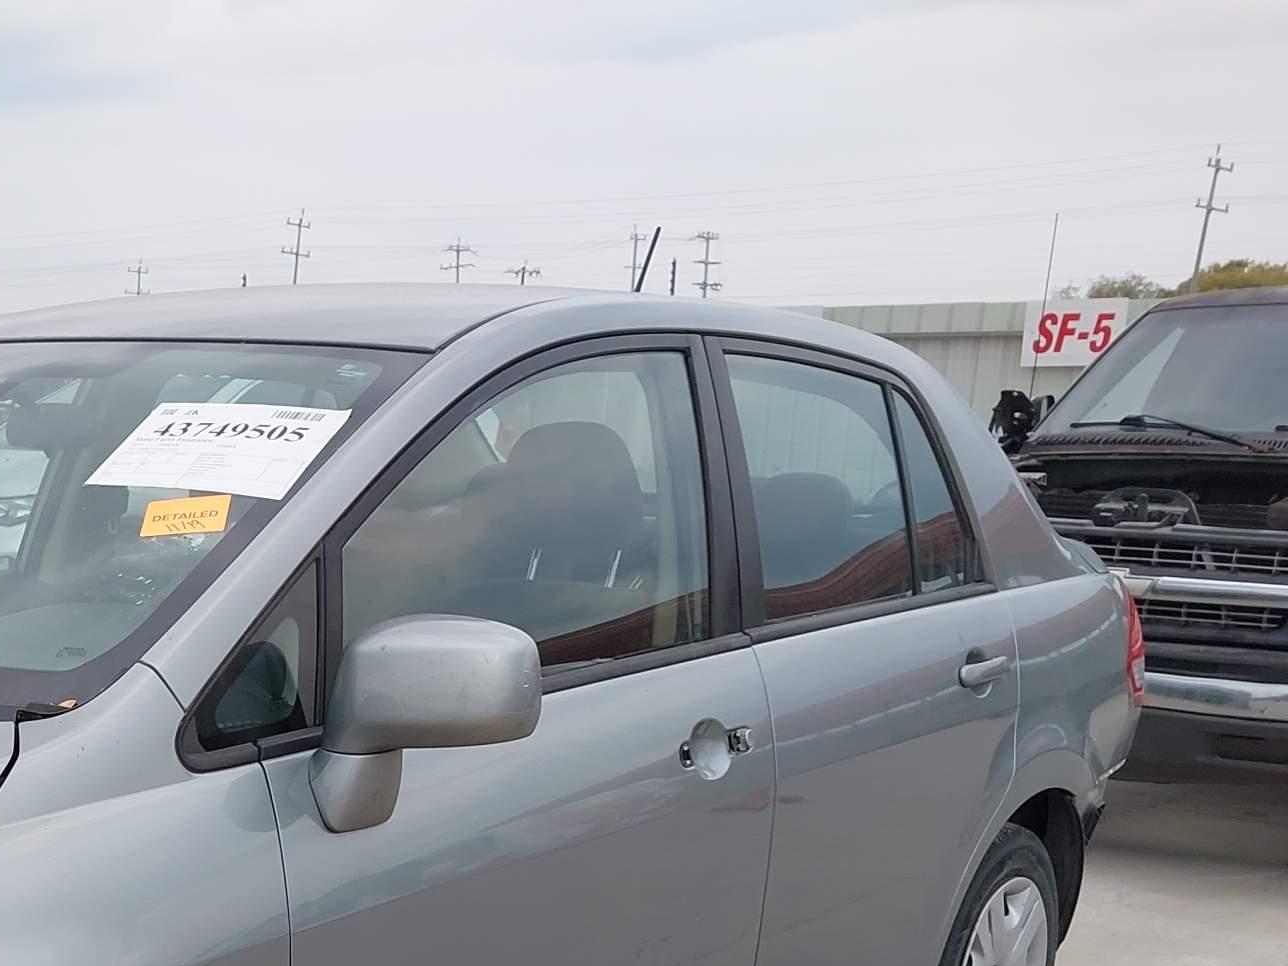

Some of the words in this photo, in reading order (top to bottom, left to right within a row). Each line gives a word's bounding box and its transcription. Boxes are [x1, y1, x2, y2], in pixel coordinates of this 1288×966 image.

[1032, 313, 1116, 353] SF-5
[153, 421, 310, 442] 43749505
[152, 510, 219, 523] DETAILED
